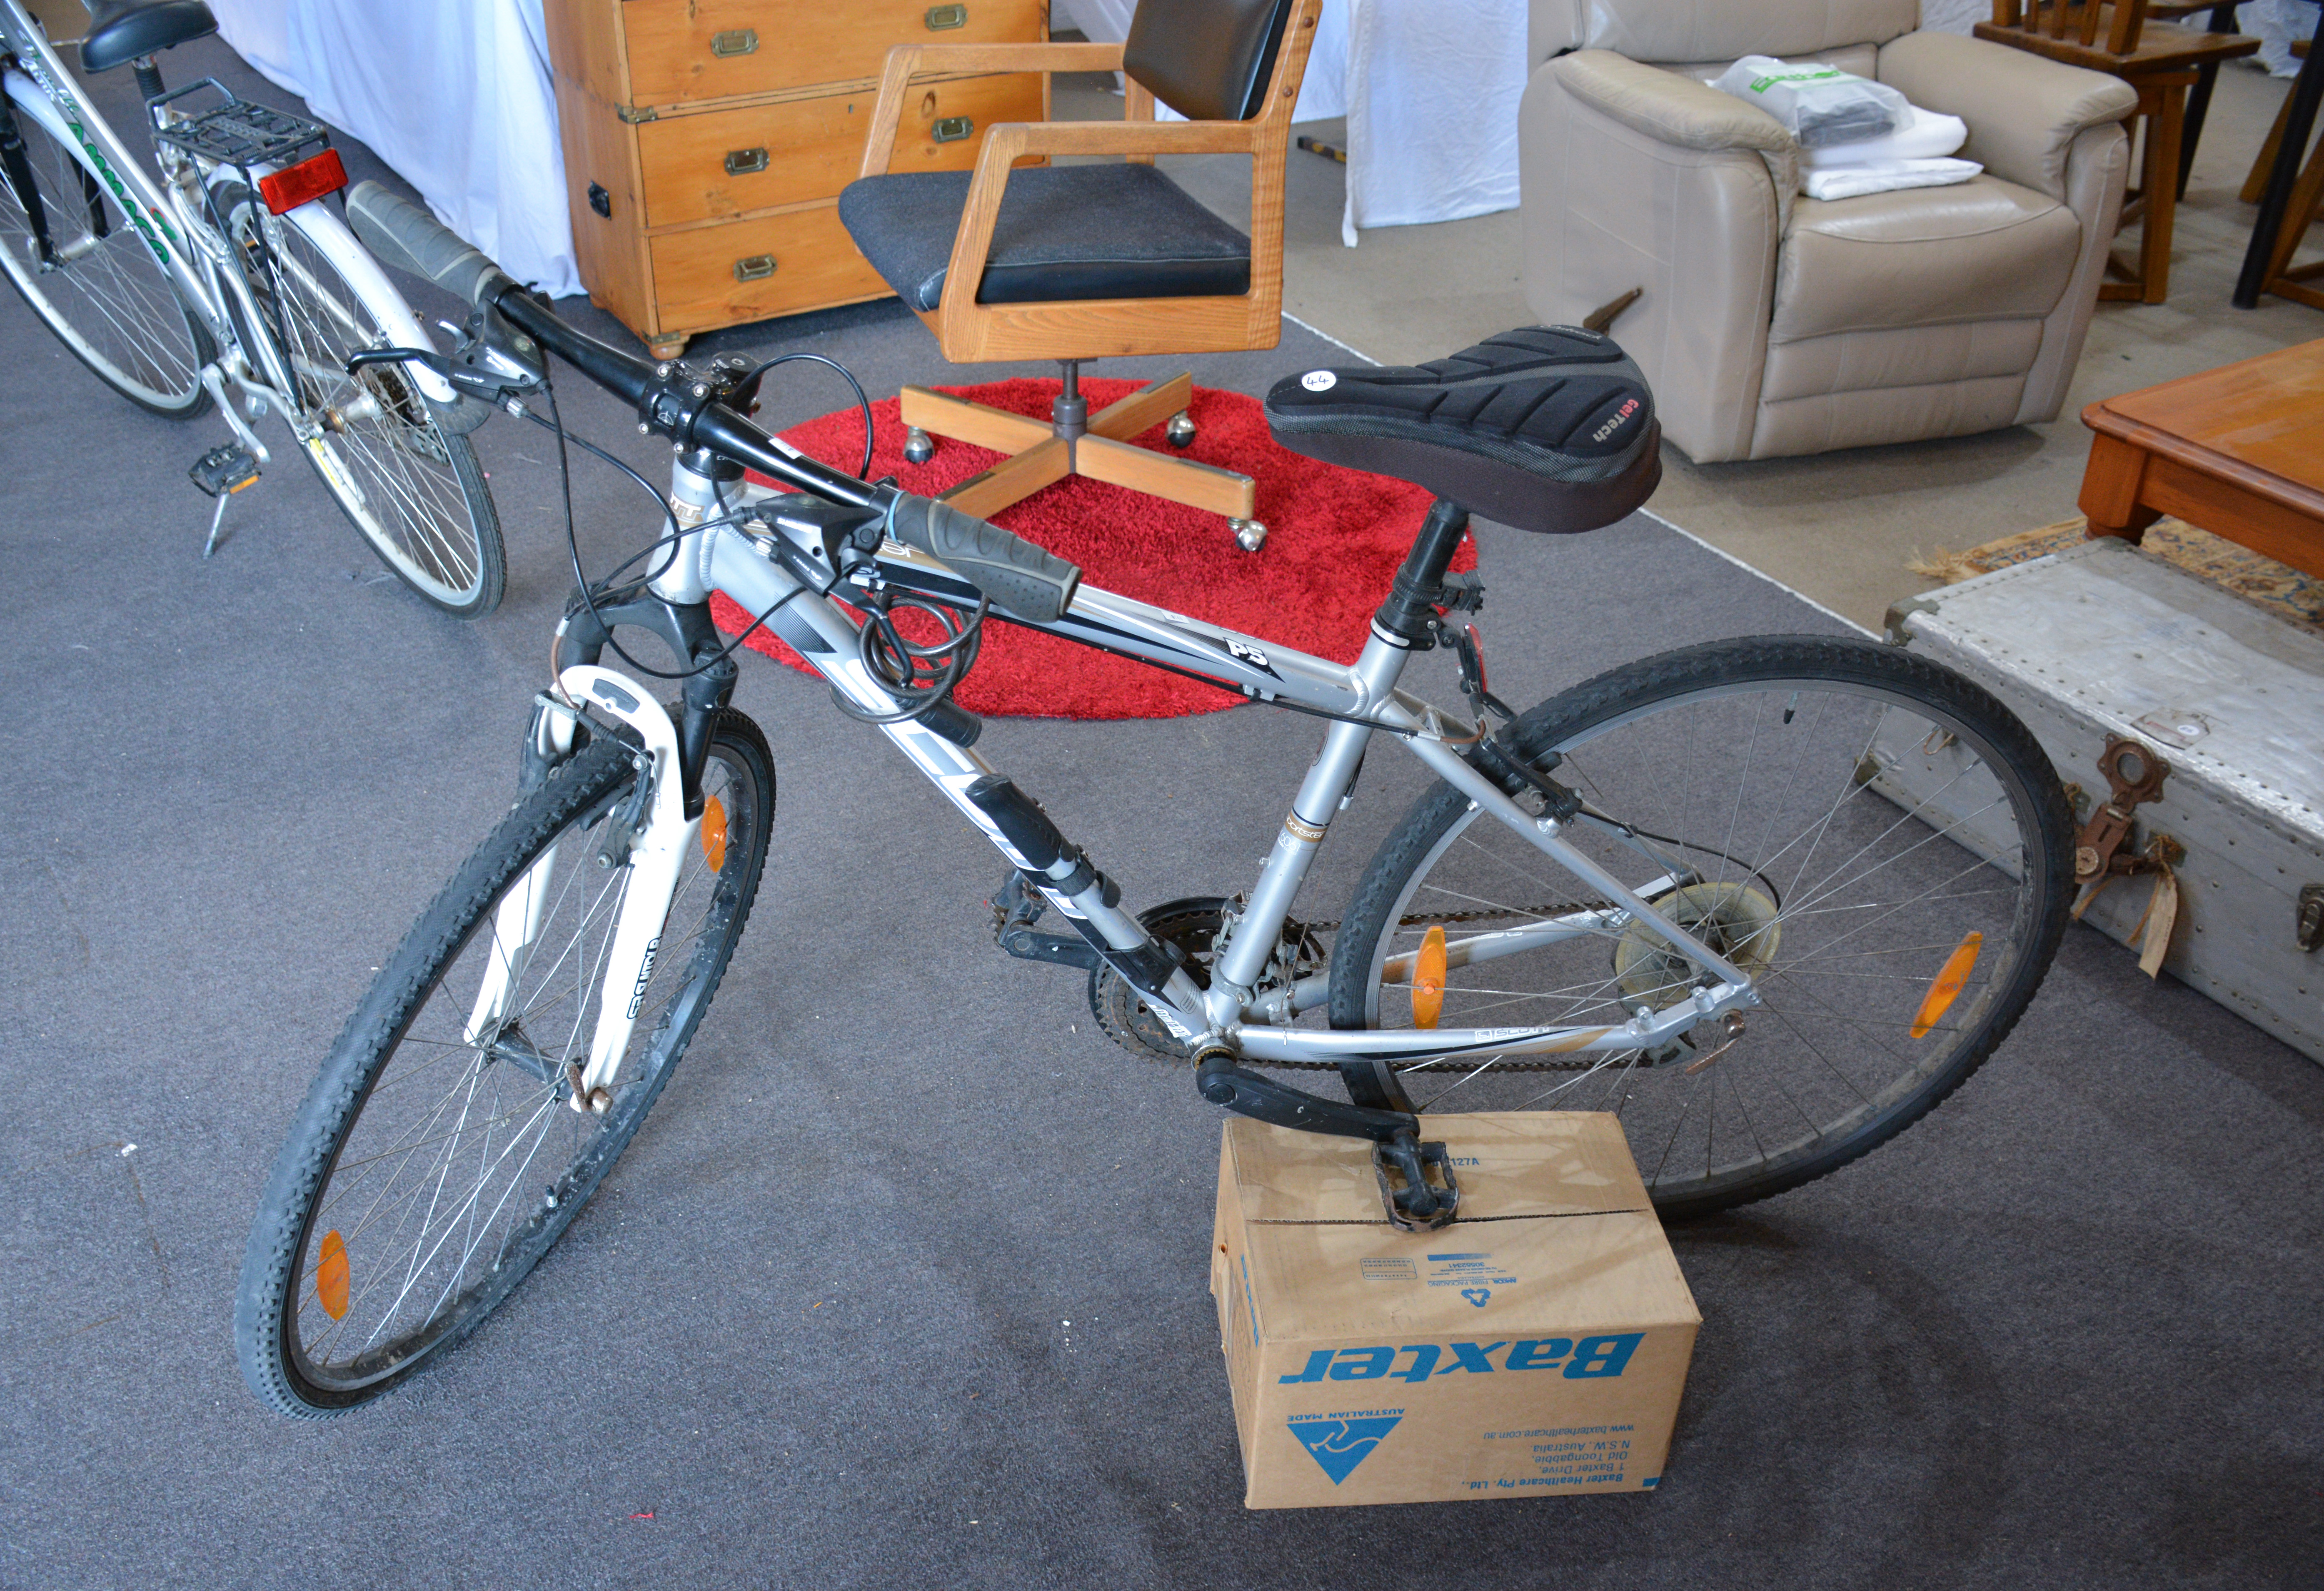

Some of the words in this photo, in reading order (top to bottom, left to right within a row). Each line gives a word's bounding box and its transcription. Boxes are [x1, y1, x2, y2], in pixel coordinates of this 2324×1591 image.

[1307, 375, 1329, 386] 44
[1593, 399, 1639, 442] GelTech
[1223, 637, 1269, 666] P5
[1277, 1332, 1647, 1385] Baxter
[1287, 1413, 1323, 1421] MADE
[1329, 1408, 1405, 1419] AUSTRALIAN
[1484, 1424, 1634, 1439] www.baxterhealthcare.com.au
[1532, 1453, 1603, 1463] Toongabbie,
[1608, 1451, 1628, 1461] Old
[1539, 1465, 1572, 1474] Drive,
[1577, 1463, 1614, 1472] Baxter
[1494, 1478, 1515, 1488] Pty.
[1519, 1476, 1583, 1486] Healthcare
[1586, 1474, 1623, 1482] Baxter
